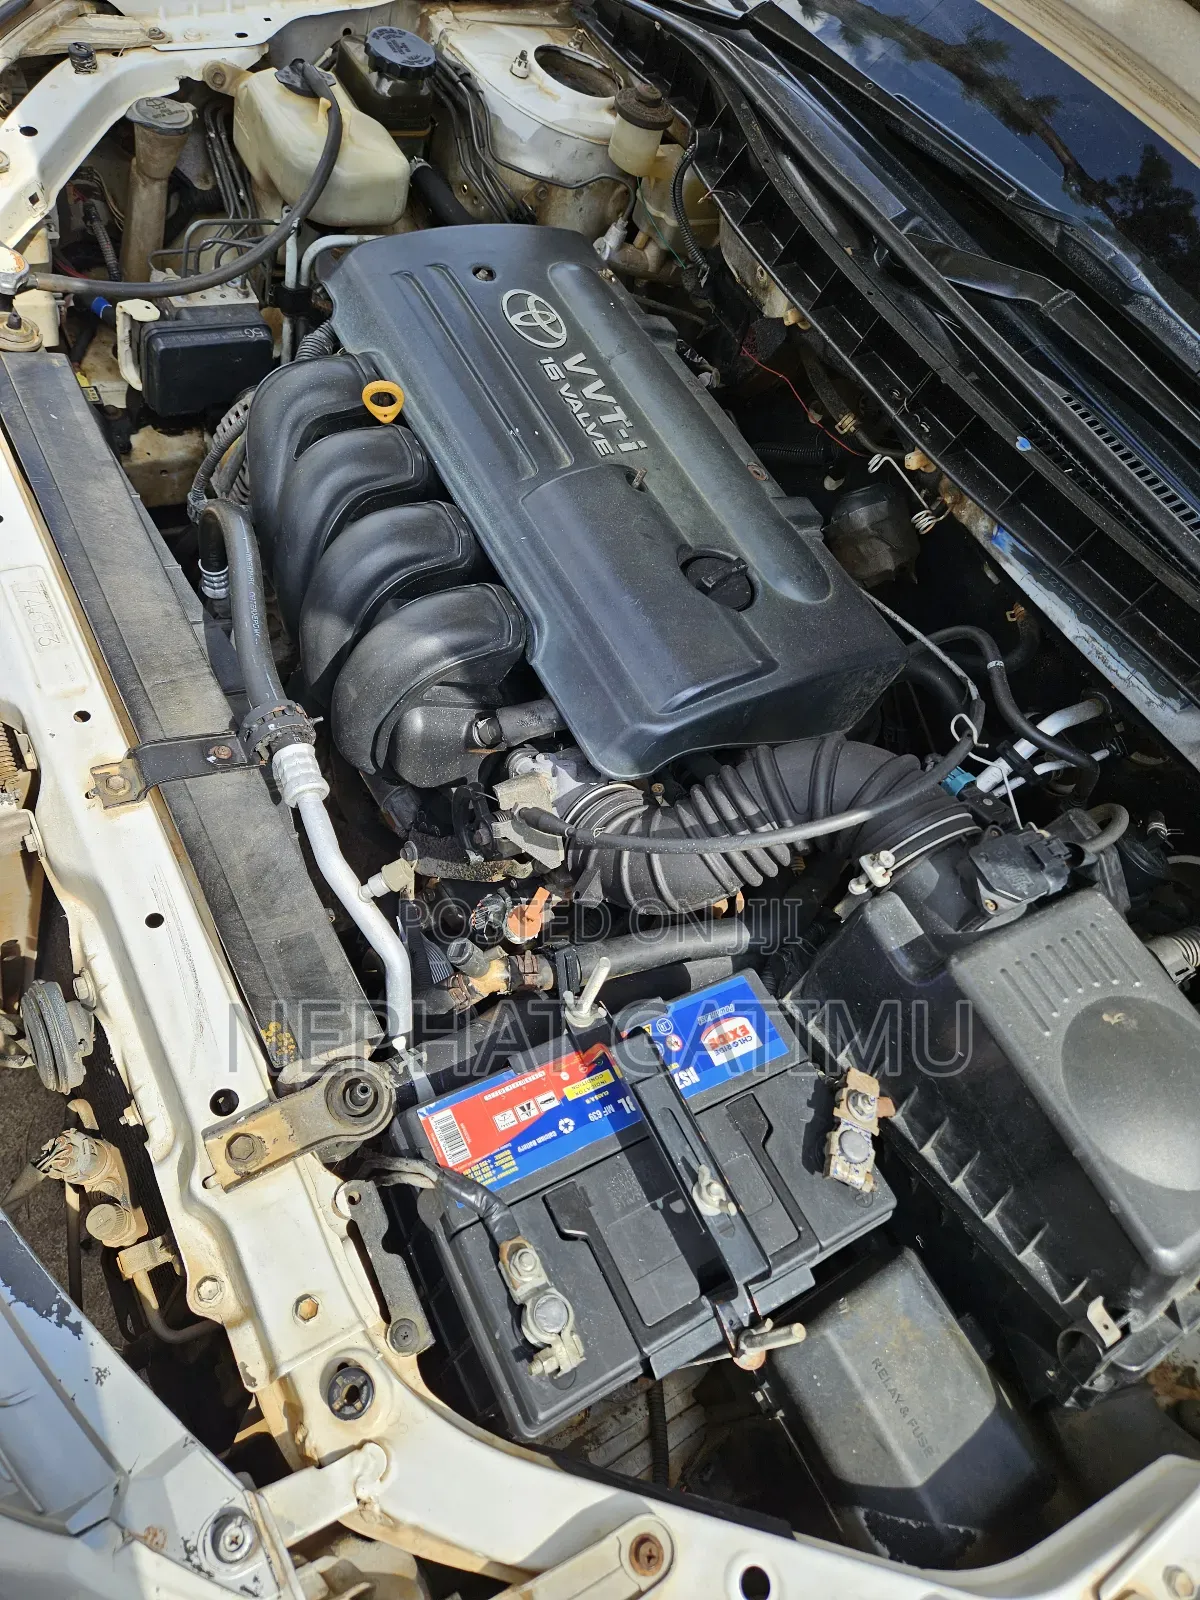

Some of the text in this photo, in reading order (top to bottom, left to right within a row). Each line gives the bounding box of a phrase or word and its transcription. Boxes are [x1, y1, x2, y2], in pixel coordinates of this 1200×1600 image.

[538, 356, 614, 457] 16 VALVE
[562, 352, 647, 452] VVT-i
[707, 1024, 750, 1051] EXIDE
[714, 1035, 753, 1056] CHLORIDE
[571, 1073, 604, 1090] CONDITION
[575, 1080, 607, 1096] INDICATOR
[588, 1109, 603, 1122] 639
[517, 1139, 538, 1153] Battery
[871, 1357, 935, 1459] RELAY & FUSE
